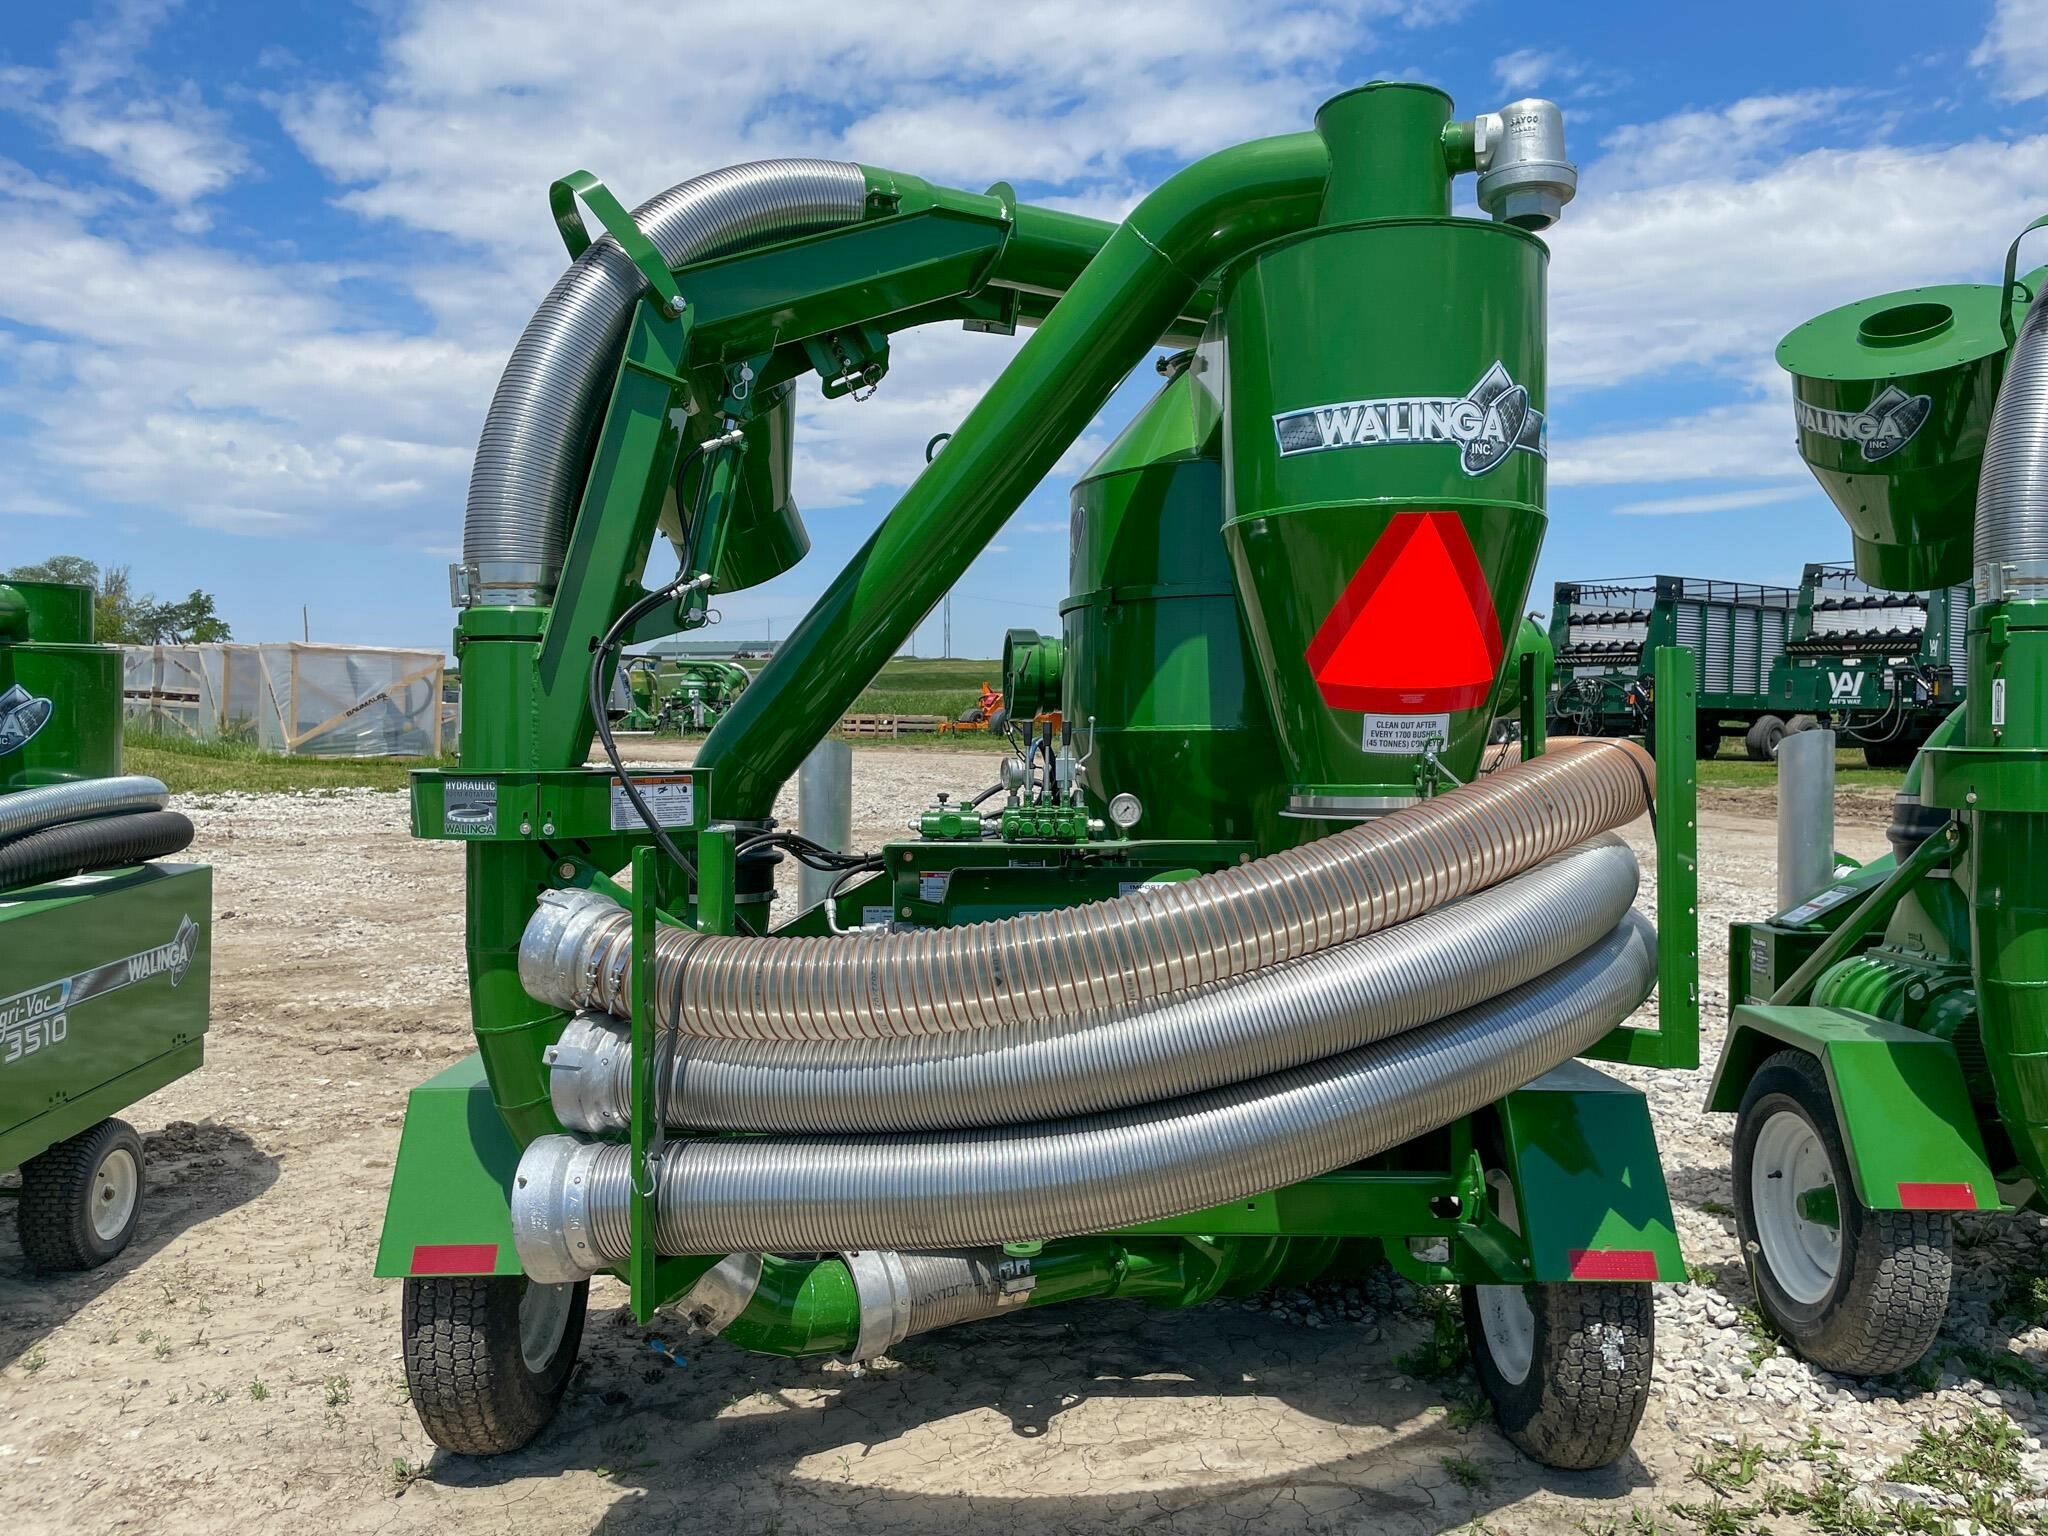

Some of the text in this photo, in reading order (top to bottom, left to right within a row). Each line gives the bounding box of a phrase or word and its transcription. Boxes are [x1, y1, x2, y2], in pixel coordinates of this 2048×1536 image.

[1315, 400, 1506, 447] WALINGA
[1793, 399, 1902, 441] WALINGA
[1470, 442, 1493, 456] INC.
[1869, 440, 1889, 450] INC.
[1376, 720, 1437, 730] CLEAN OUT AFTER
[1370, 729, 1393, 738] EVERY
[1395, 730, 1411, 739] 1700
[1366, 738, 1378, 748] (45
[1379, 739, 1410, 749] TONNES)
[445, 781, 496, 791] HYDRAULIC
[445, 823, 495, 834] WALINGA
[128, 942, 188, 981] WALINGA
[0, 993, 51, 1043] gri-Vac
[5, 1012, 67, 1062] 3510
